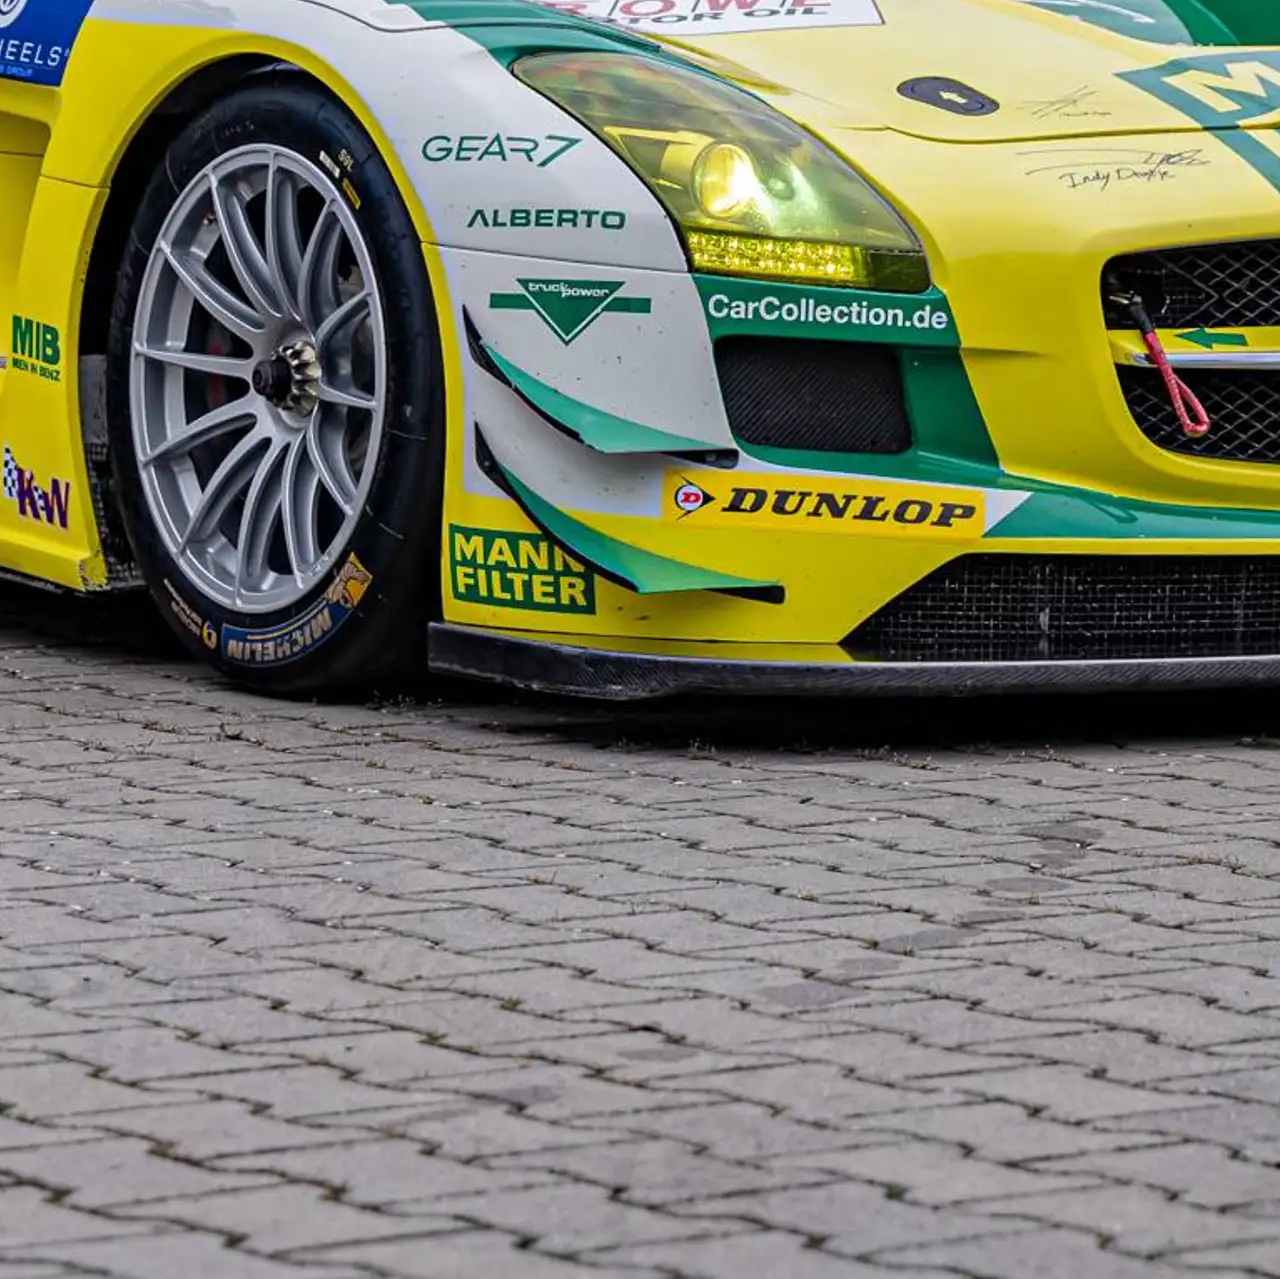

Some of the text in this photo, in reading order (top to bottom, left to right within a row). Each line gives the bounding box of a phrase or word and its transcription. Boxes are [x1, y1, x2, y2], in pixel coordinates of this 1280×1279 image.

[742, 6, 829, 19] OIL
[467, 208, 627, 230] ALBERTO
[708, 293, 949, 330] CarCollection.de
[12, 314, 60, 365] MIB
[722, 487, 976, 528] DUNLOP
[456, 565, 588, 607] FILTER
[227, 608, 332, 662] MICHELIN
